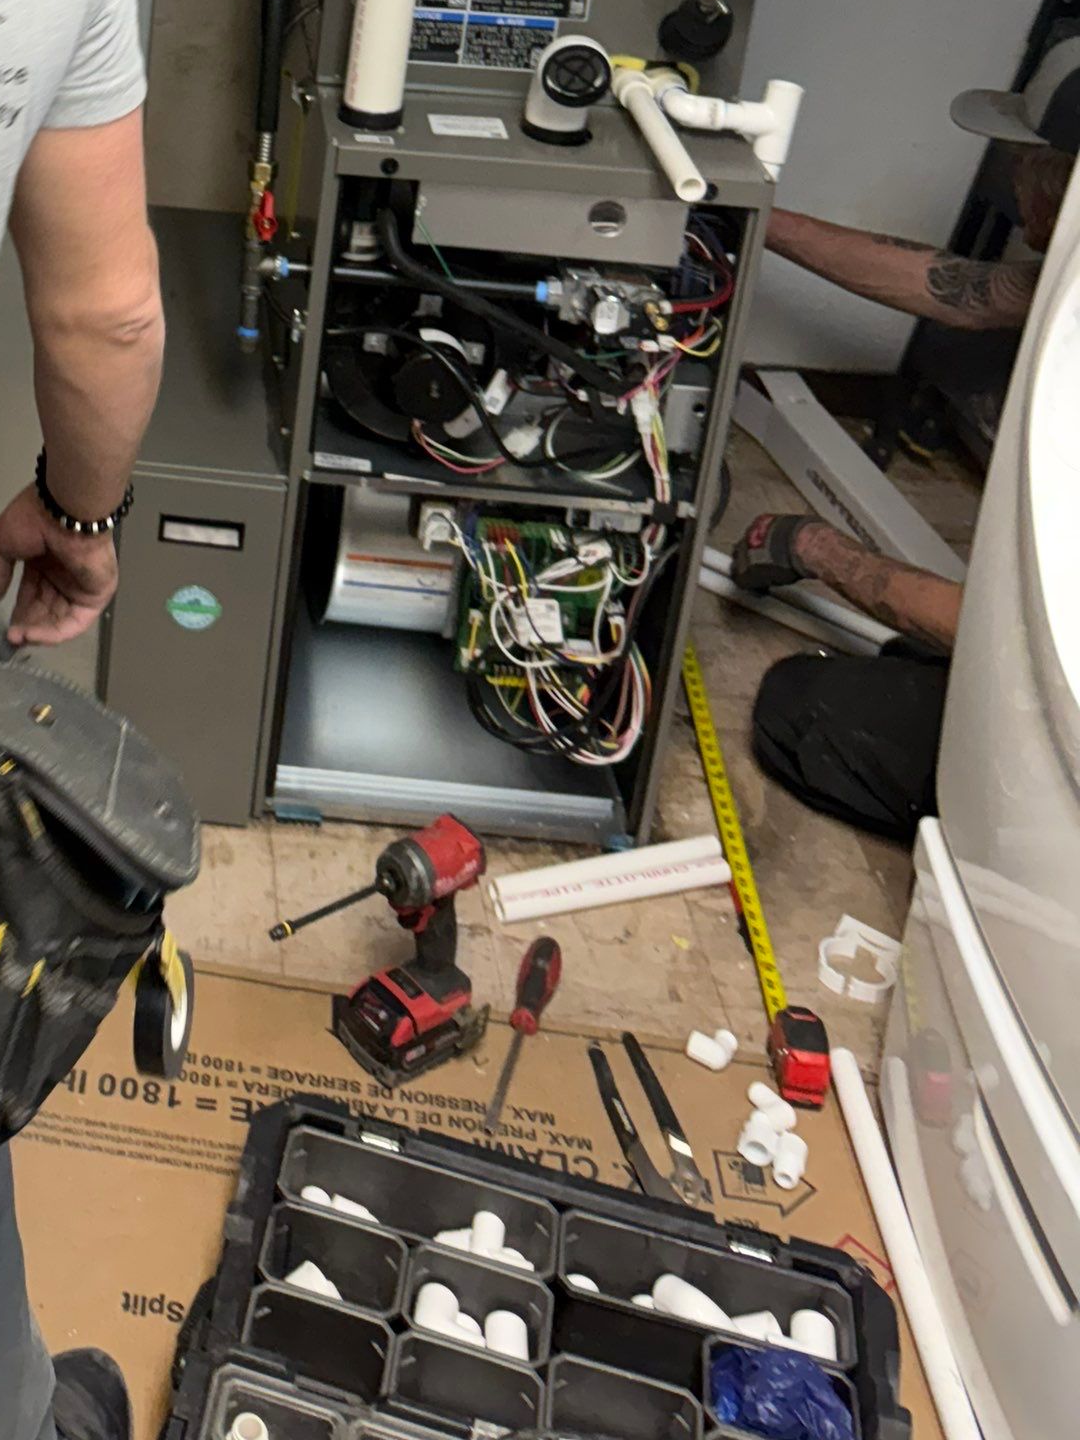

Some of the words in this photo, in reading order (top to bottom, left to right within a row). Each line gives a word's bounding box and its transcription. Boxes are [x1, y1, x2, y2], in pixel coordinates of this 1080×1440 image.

[201, 1056, 245, 1073] 1800
[266, 1065, 362, 1092] SERRAGE
[98, 1072, 182, 1109] 1800
[368, 1083, 394, 1099] DE
[400, 1089, 488, 1115] RESSION
[418, 1110, 442, 1126] DE
[507, 1106, 556, 1126] MAX.
[544, 1130, 593, 1153] MAX.
[121, 1290, 186, 1323] Split
